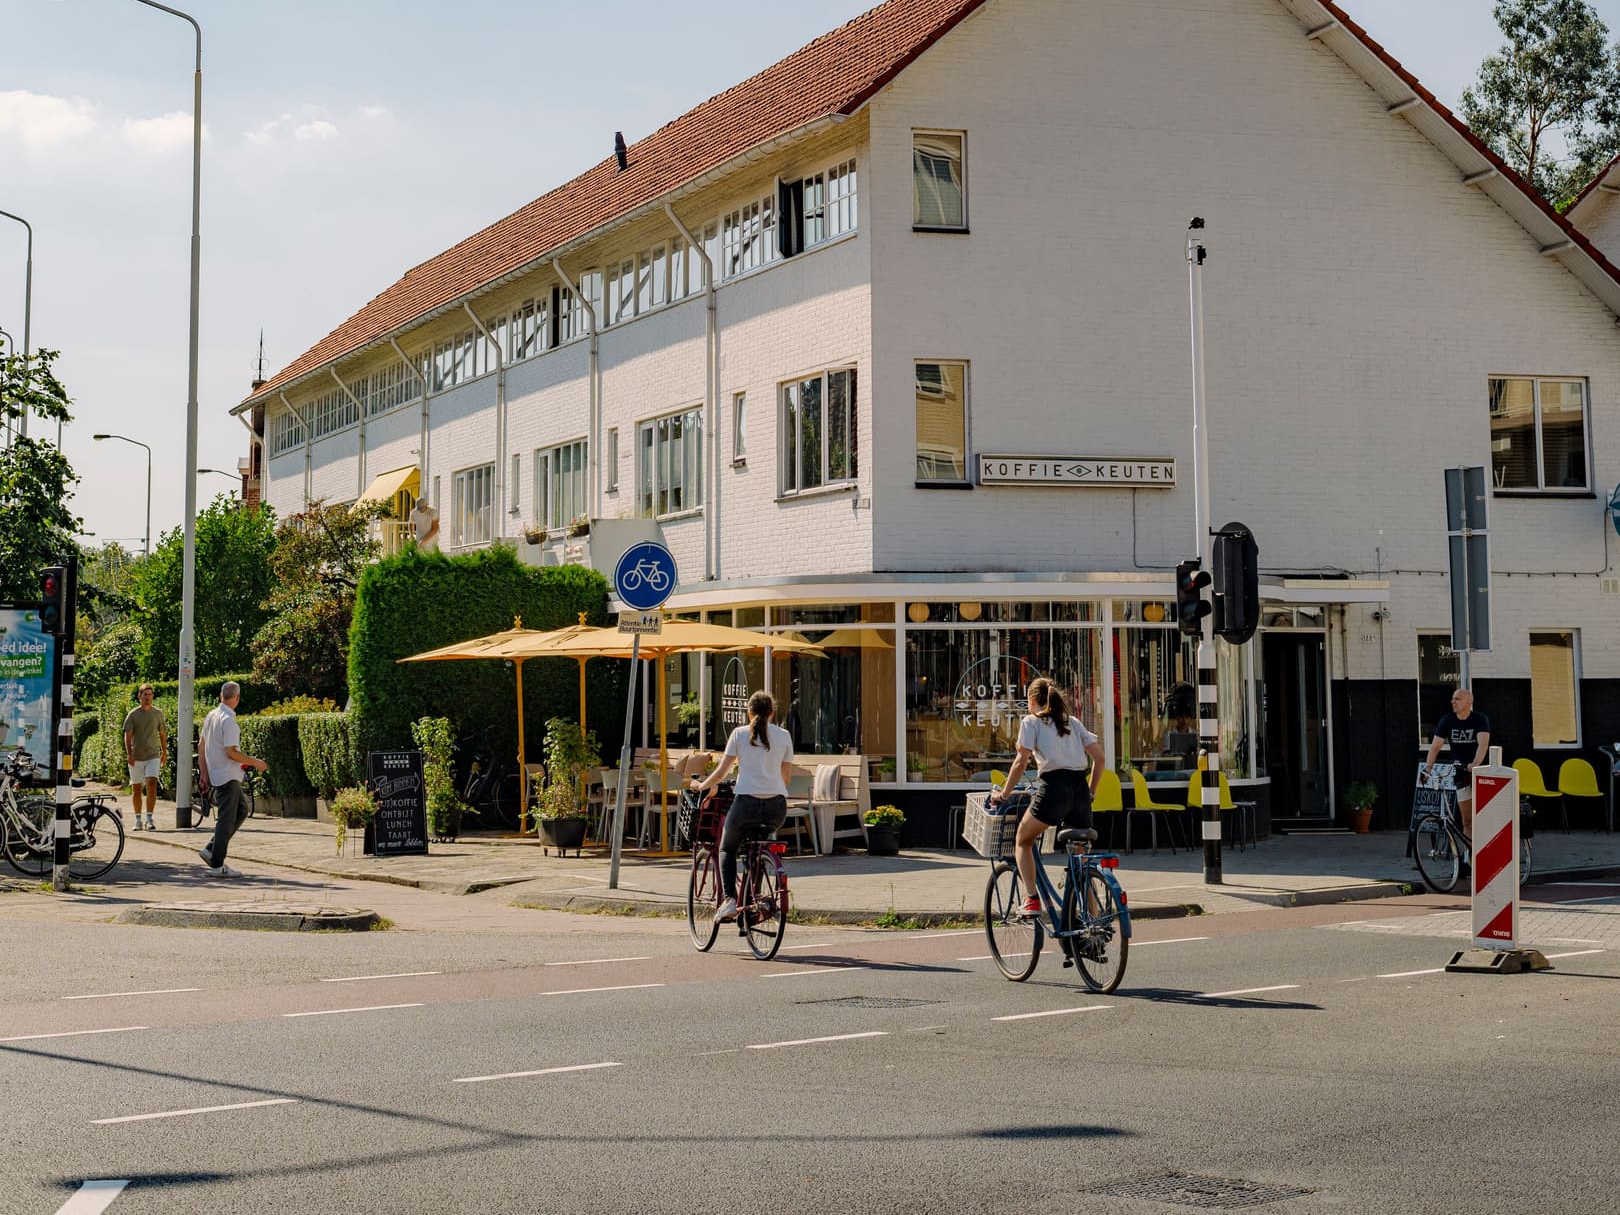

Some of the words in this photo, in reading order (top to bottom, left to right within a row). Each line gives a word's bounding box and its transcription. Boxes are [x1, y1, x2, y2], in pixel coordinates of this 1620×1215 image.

[984, 463, 1063, 477] KOFFIE
[1096, 465, 1174, 479] KEUTEN
[18, 641, 47, 653] idee!
[723, 683, 747, 697] KOFFIE
[962, 684, 1027, 698] KOFFI
[723, 711, 747, 724] KEUTEN
[962, 714, 1026, 727] KEUT
[1451, 728, 1474, 740] EA7
